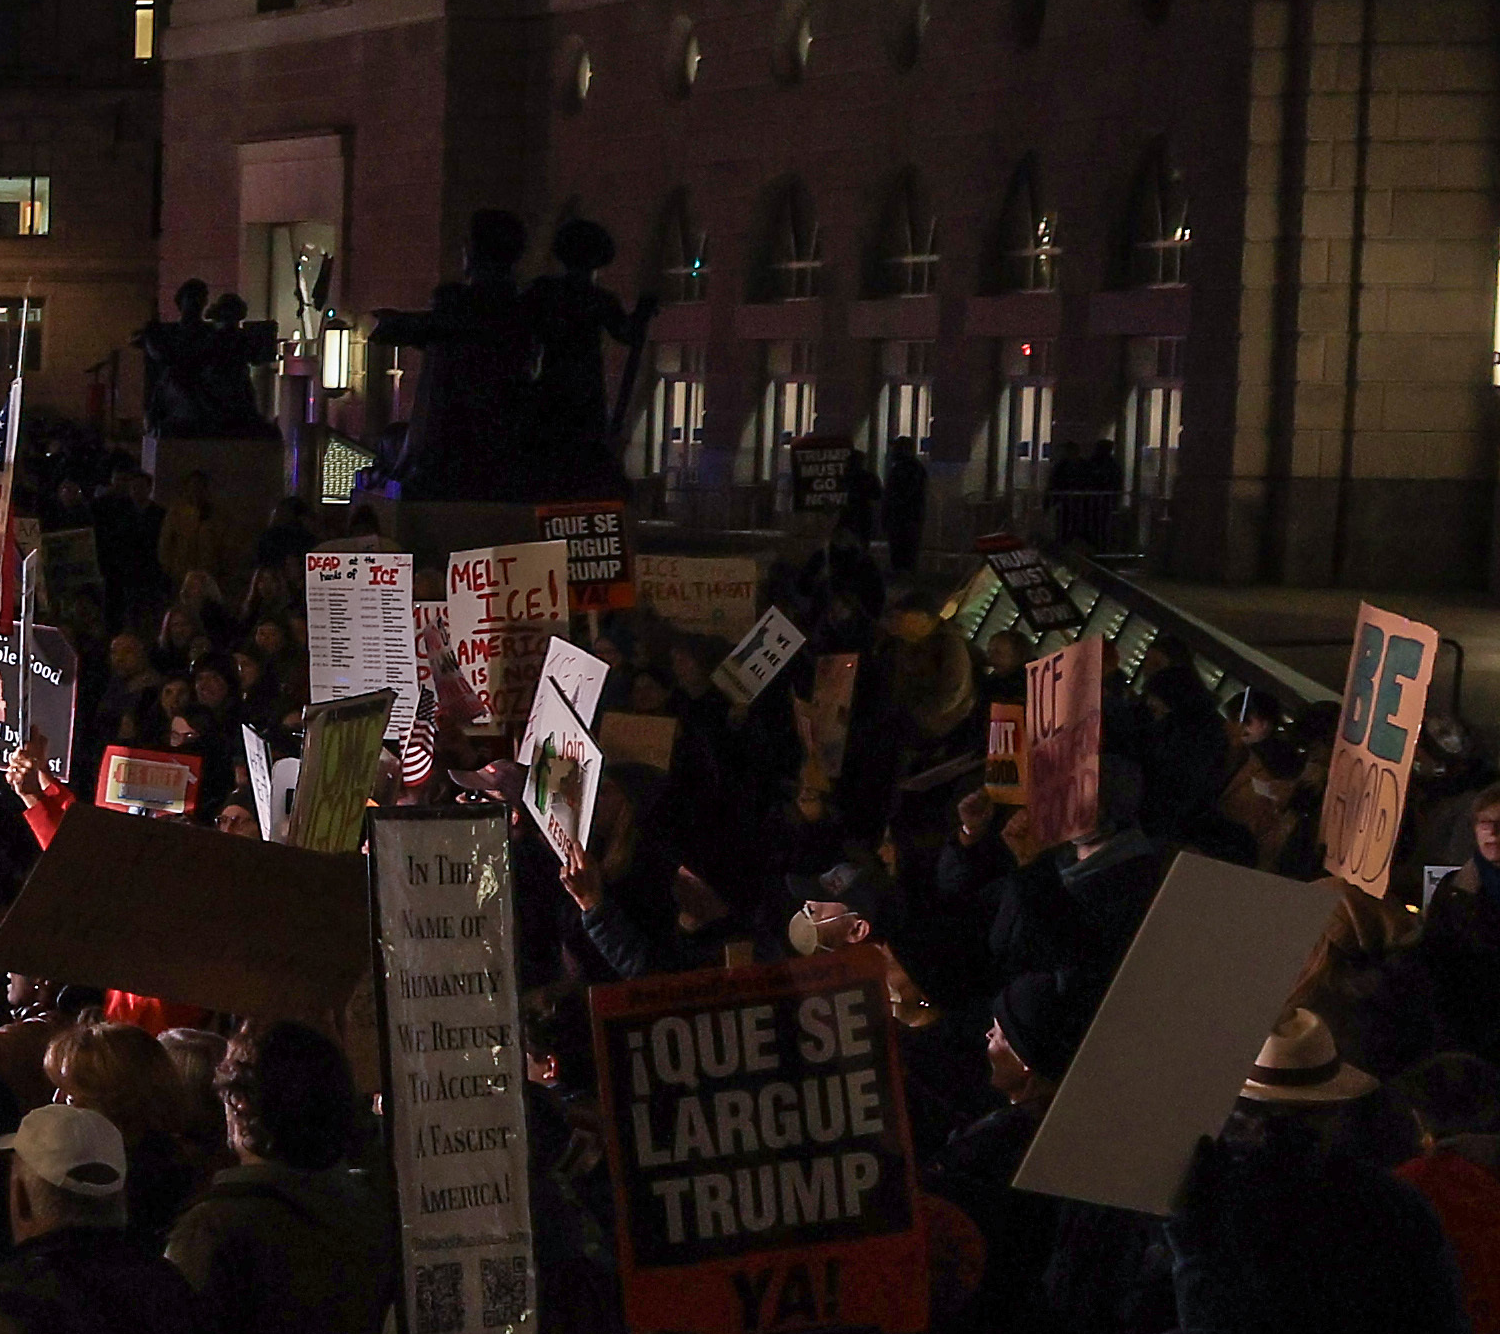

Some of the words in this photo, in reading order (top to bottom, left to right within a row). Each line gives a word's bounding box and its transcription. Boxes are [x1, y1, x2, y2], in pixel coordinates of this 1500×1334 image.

[795, 448, 850, 463] TRUMP
[800, 463, 846, 478] MUST
[812, 477, 837, 491] GO
[544, 516, 590, 539] ¡QUE
[593, 513, 620, 535] SE
[568, 536, 622, 559] RGUE
[307, 556, 341, 572] DEAD
[320, 570, 342, 581] hands
[347, 568, 358, 580] of
[369, 566, 399, 586] ICE
[451, 557, 518, 595] MELT
[568, 559, 622, 582] RUMP
[477, 569, 560, 624] ICE!
[457, 635, 546, 666] AMERIC
[471, 668, 488, 686] IS
[1030, 652, 1064, 746] ICE
[1342, 621, 1425, 765] BE
[5, 725, 21, 747] by
[561, 732, 586, 762] Join
[548, 813, 573, 853] RESIS
[407, 855, 429, 886] IN
[435, 852, 475, 885] THE
[402, 910, 457, 941] NAME
[461, 913, 484, 938] OF
[400, 969, 501, 1000] HUMANITY
[399, 1025, 428, 1053] WE
[432, 1021, 513, 1053] REFUSE
[627, 1003, 781, 1096] ¡QUE
[798, 989, 873, 1064] SE
[407, 1071, 432, 1104] TO
[436, 1070, 513, 1102] ACCEPT
[631, 1067, 884, 1167] LARGUE
[416, 1127, 427, 1159] A
[429, 1124, 512, 1157] FASCIST
[419, 1171, 512, 1216] AMERICA!
[650, 1150, 880, 1246] TRUMP
[731, 1253, 846, 1331] YA!
